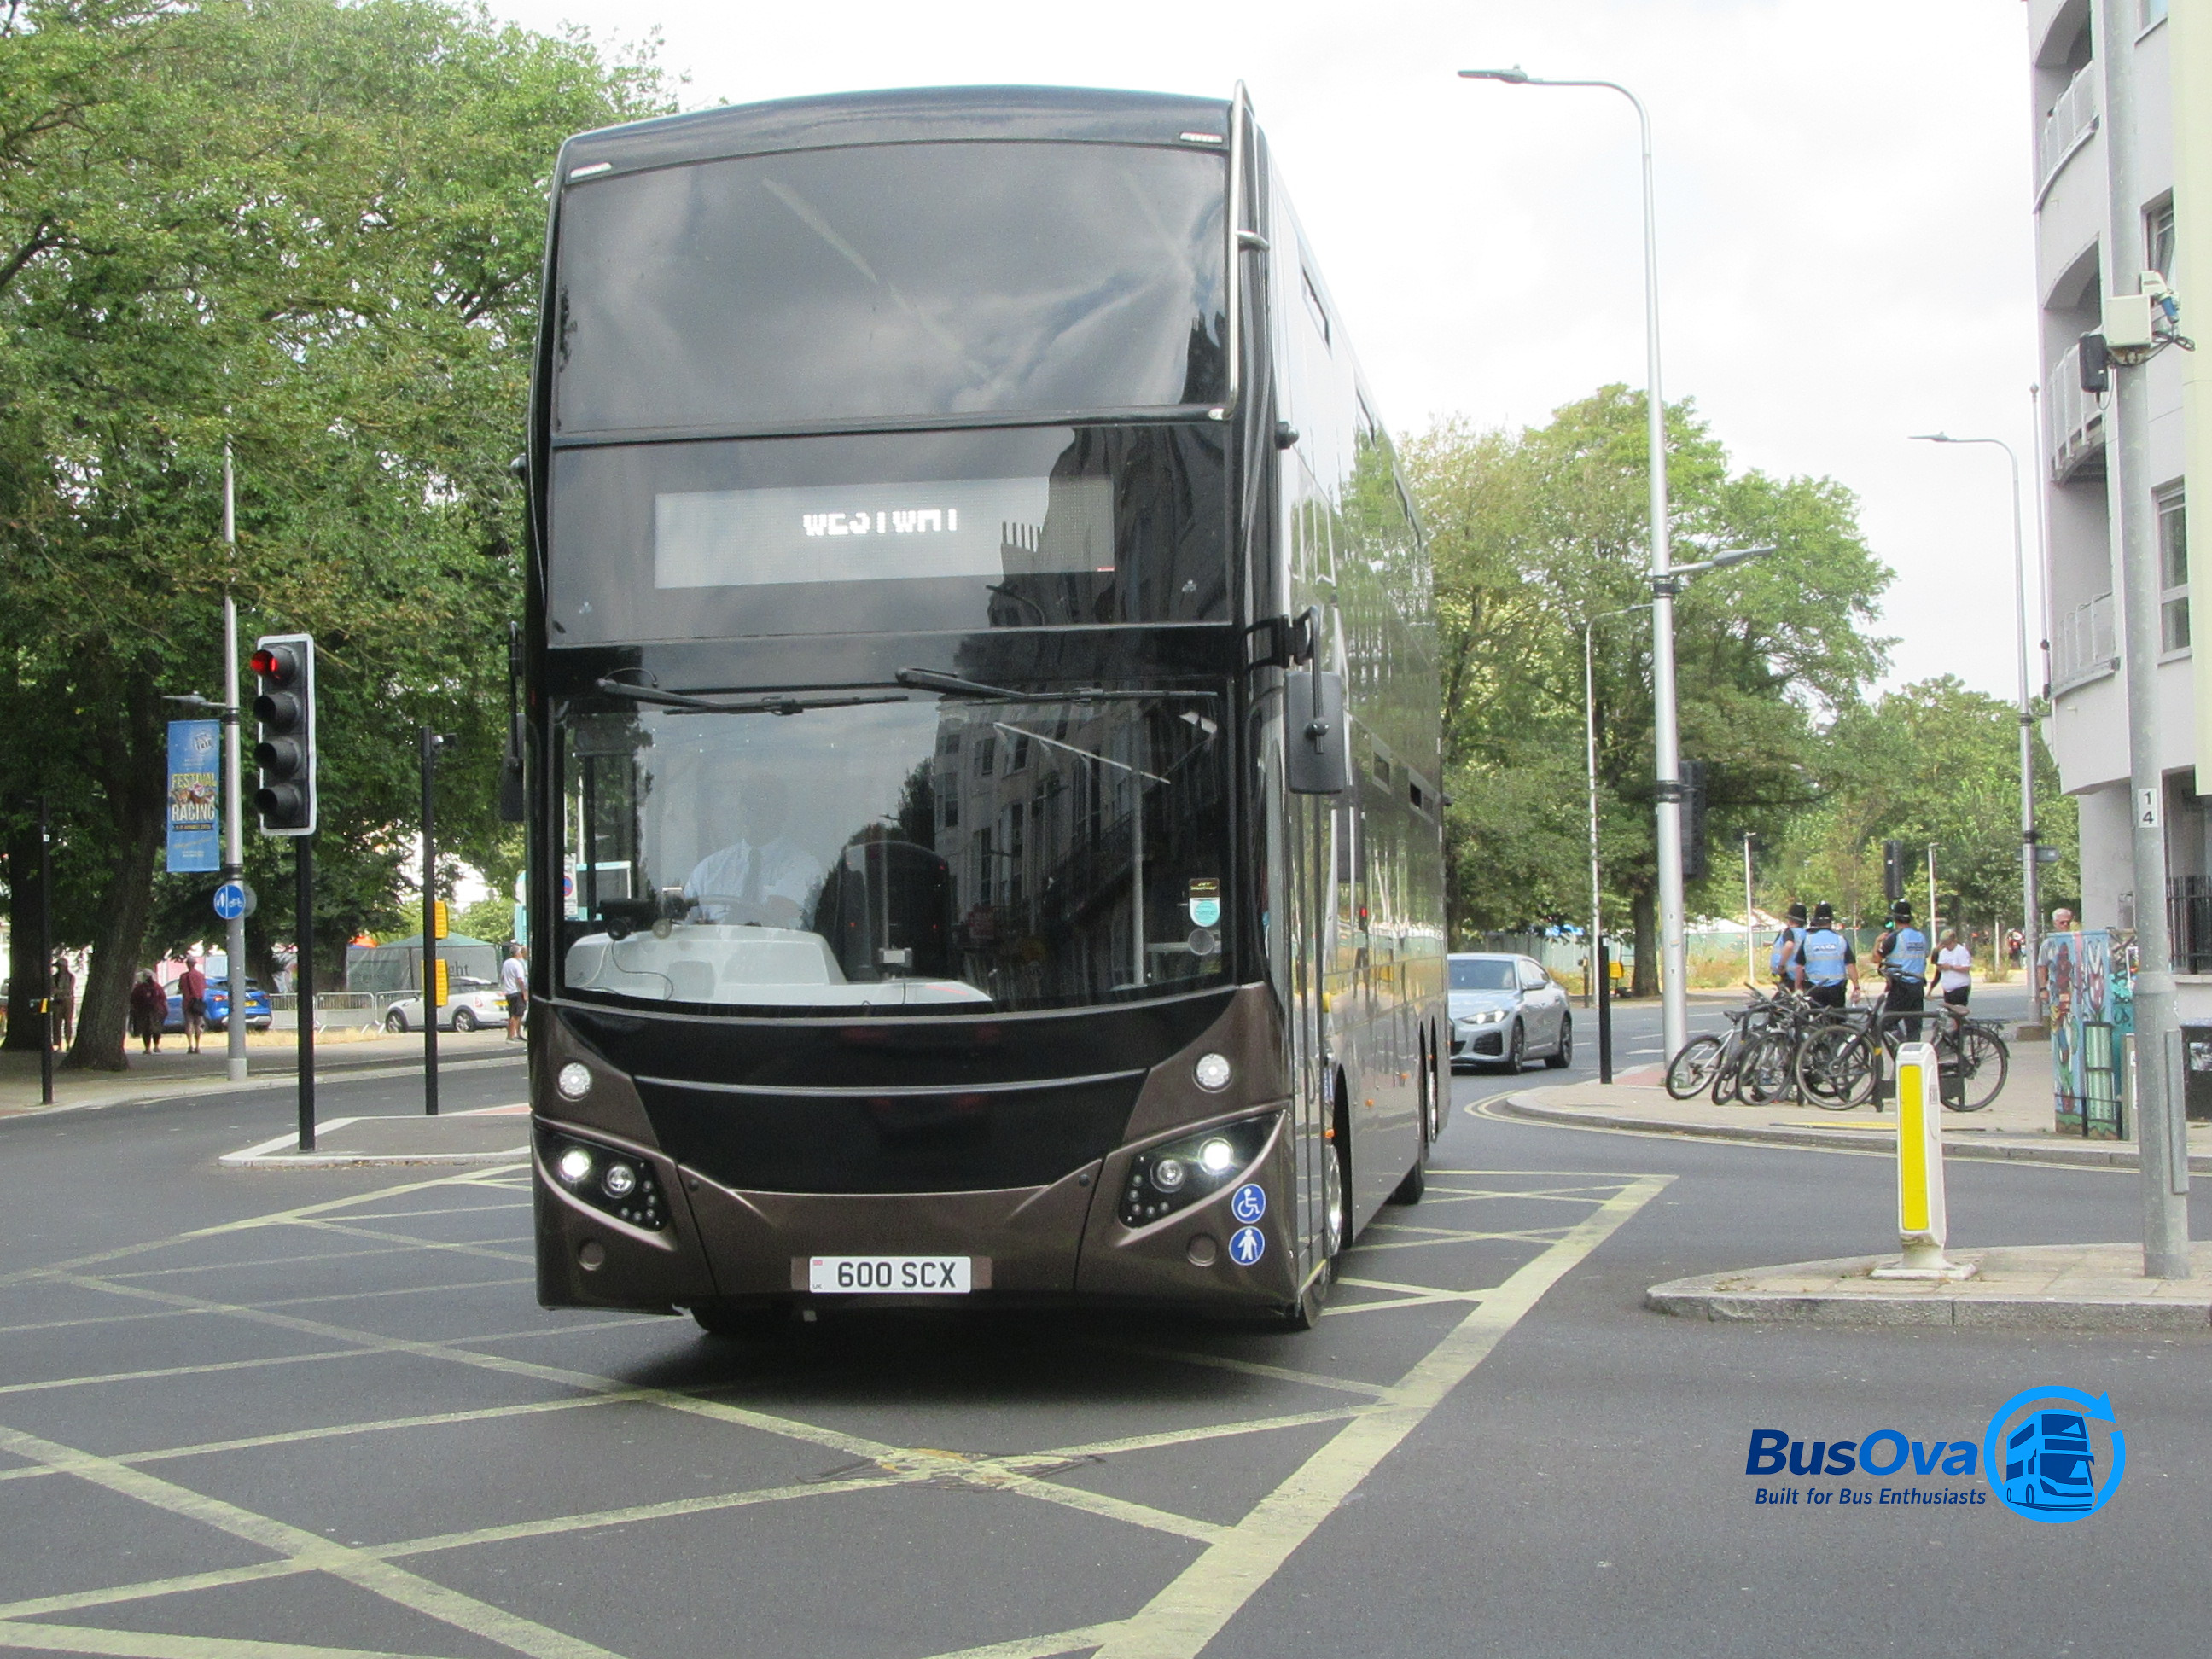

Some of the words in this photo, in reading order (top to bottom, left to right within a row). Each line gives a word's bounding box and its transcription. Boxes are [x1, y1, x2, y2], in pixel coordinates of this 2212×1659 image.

[172, 772, 217, 789] FESTIVAL
[172, 802, 215, 821] RACING
[838, 1261, 892, 1288] 600
[901, 1261, 957, 1288] SCX
